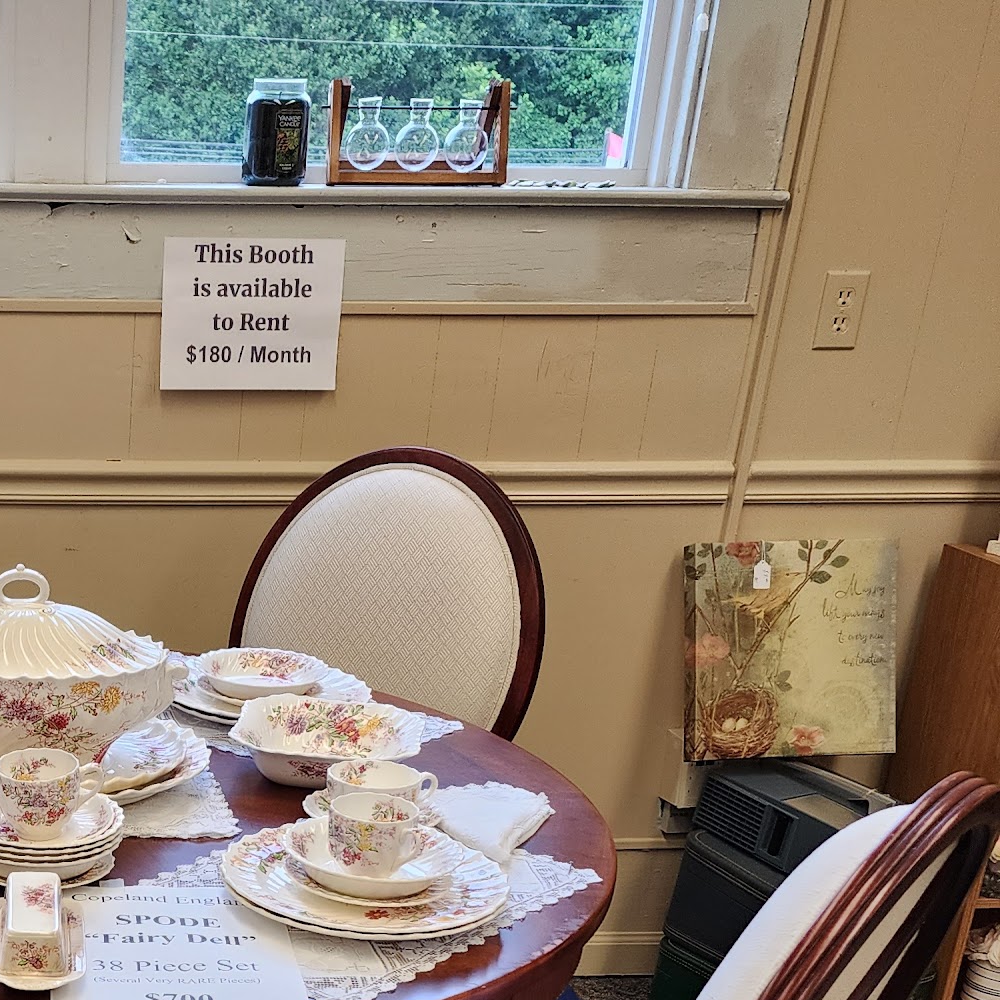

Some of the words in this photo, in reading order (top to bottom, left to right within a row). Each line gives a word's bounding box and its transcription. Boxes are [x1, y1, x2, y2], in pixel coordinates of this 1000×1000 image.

[194, 243, 243, 264] This
[249, 244, 314, 264] Booth
[193, 277, 211, 297] is
[217, 278, 312, 298] available
[213, 313, 234, 331] to
[240, 313, 290, 331] Rent
[186, 344, 231, 364] $180
[238, 345, 244, 363] /
[250, 346, 311, 363] Month
[71, 893, 167, 904] Copeland
[176, 895, 242, 906] Englan
[115, 914, 221, 929] SPODE
[85, 932, 176, 946] “Fairy
[187, 934, 256, 946] Dell”
[92, 959, 124, 971] 38
[135, 960, 207, 972] Piece
[217, 959, 261, 972] Set
[93, 976, 141, 984] (Several
[145, 977, 174, 985] Very
[220, 977, 262, 985] Pieces)
